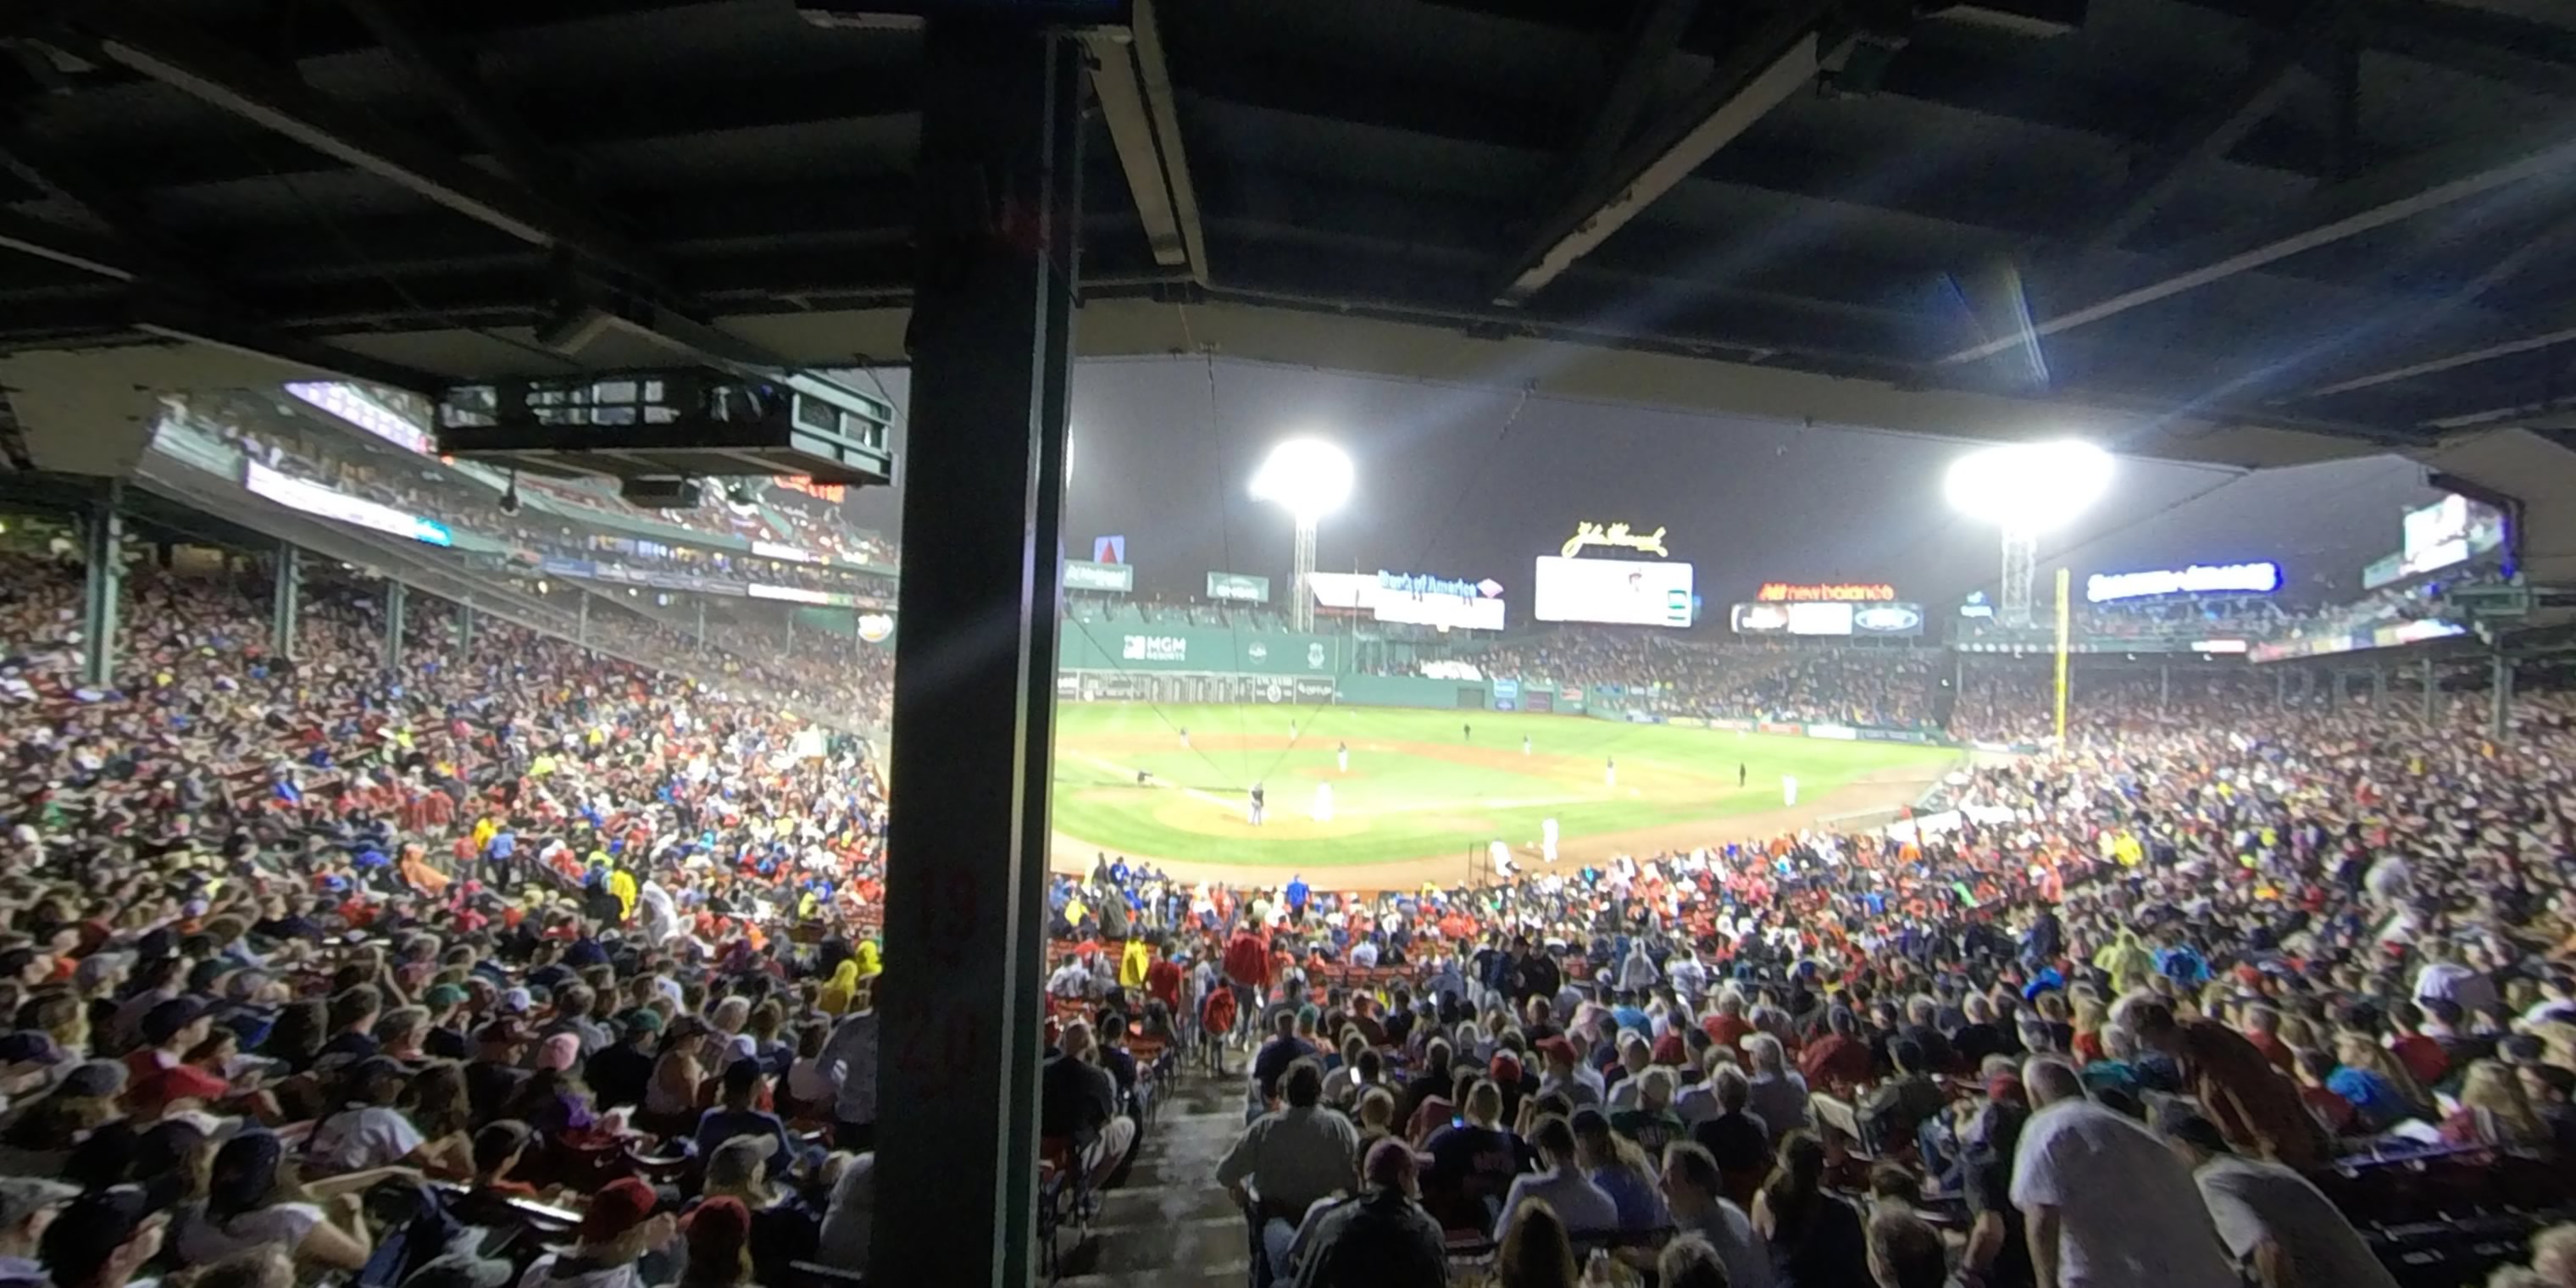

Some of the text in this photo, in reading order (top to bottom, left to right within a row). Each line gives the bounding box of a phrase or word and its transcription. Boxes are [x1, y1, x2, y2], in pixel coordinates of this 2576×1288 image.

[1378, 569, 1477, 597] Bank of America
[1788, 586, 1822, 600] new
[1822, 583, 1895, 601] balance
[1146, 636, 1186, 652] MGM
